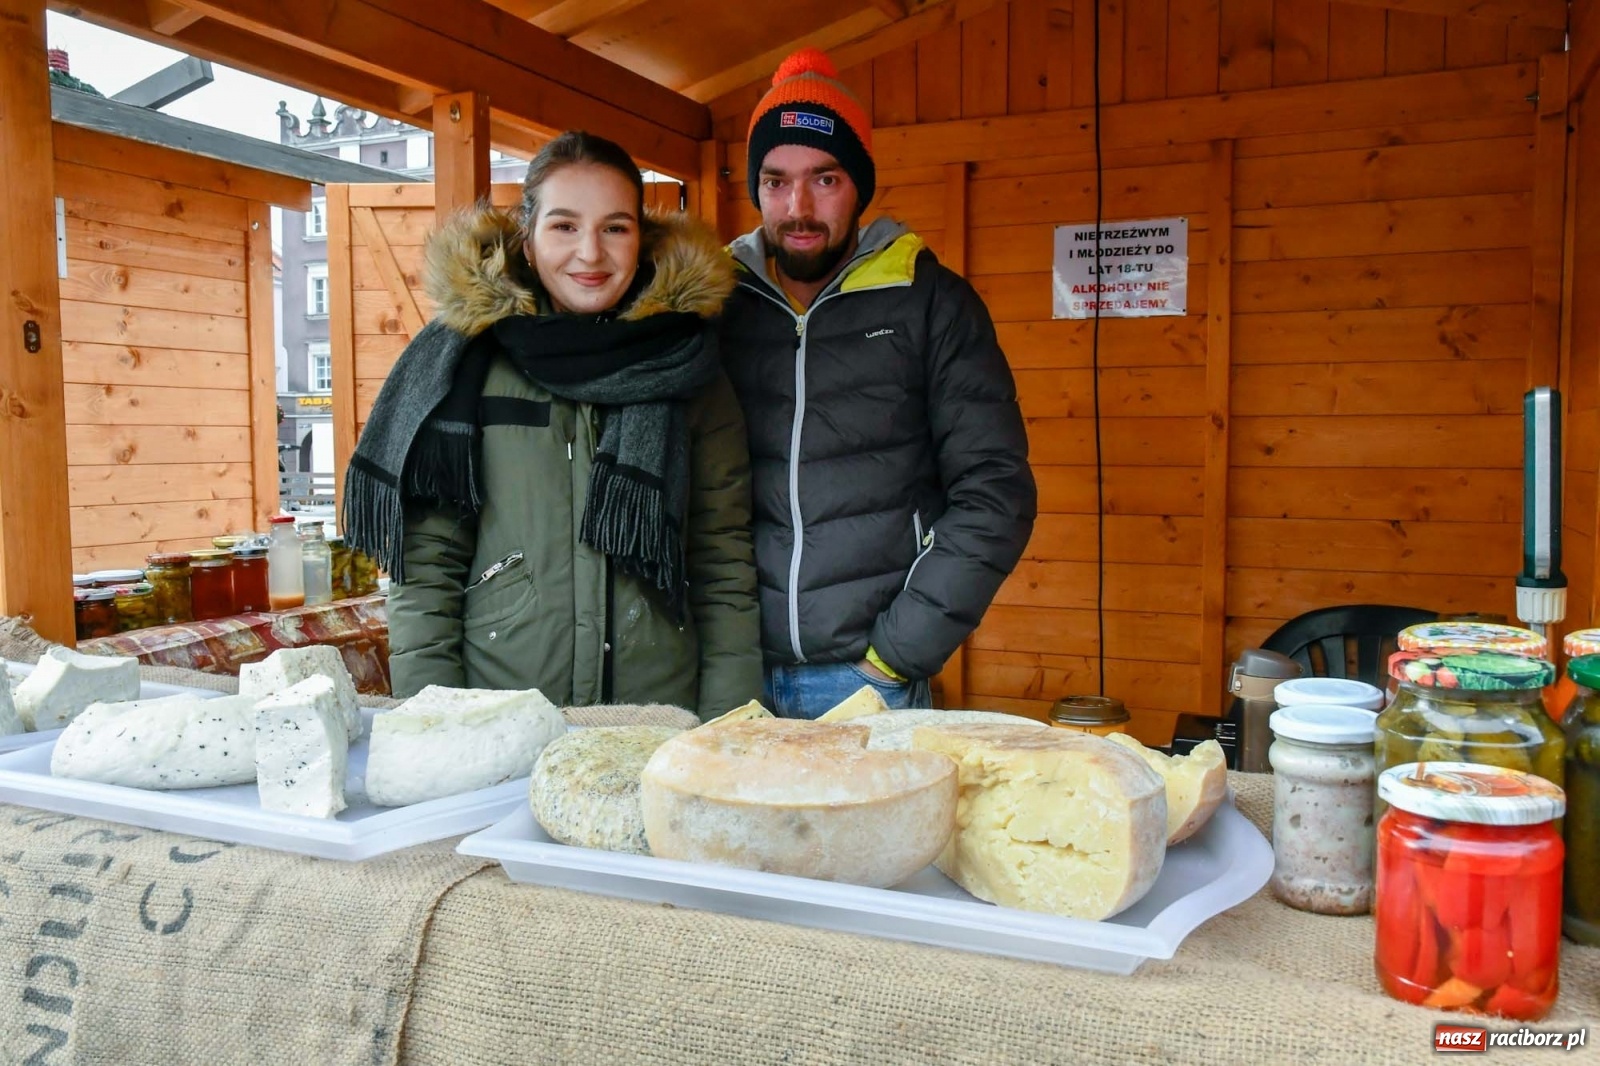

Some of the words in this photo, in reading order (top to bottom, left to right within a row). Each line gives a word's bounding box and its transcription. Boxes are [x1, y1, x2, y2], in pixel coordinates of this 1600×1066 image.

[797, 116, 832, 128] SÖLDEN
[1074, 227, 1169, 241] NIETRZEŹWYM
[1069, 250, 1073, 258] I
[1077, 244, 1151, 258] MŁODZIEŻY
[1156, 245, 1174, 254] DO
[1088, 265, 1112, 275] LAT
[1117, 263, 1153, 273] 18-TU
[1147, 282, 1169, 291] NIE
